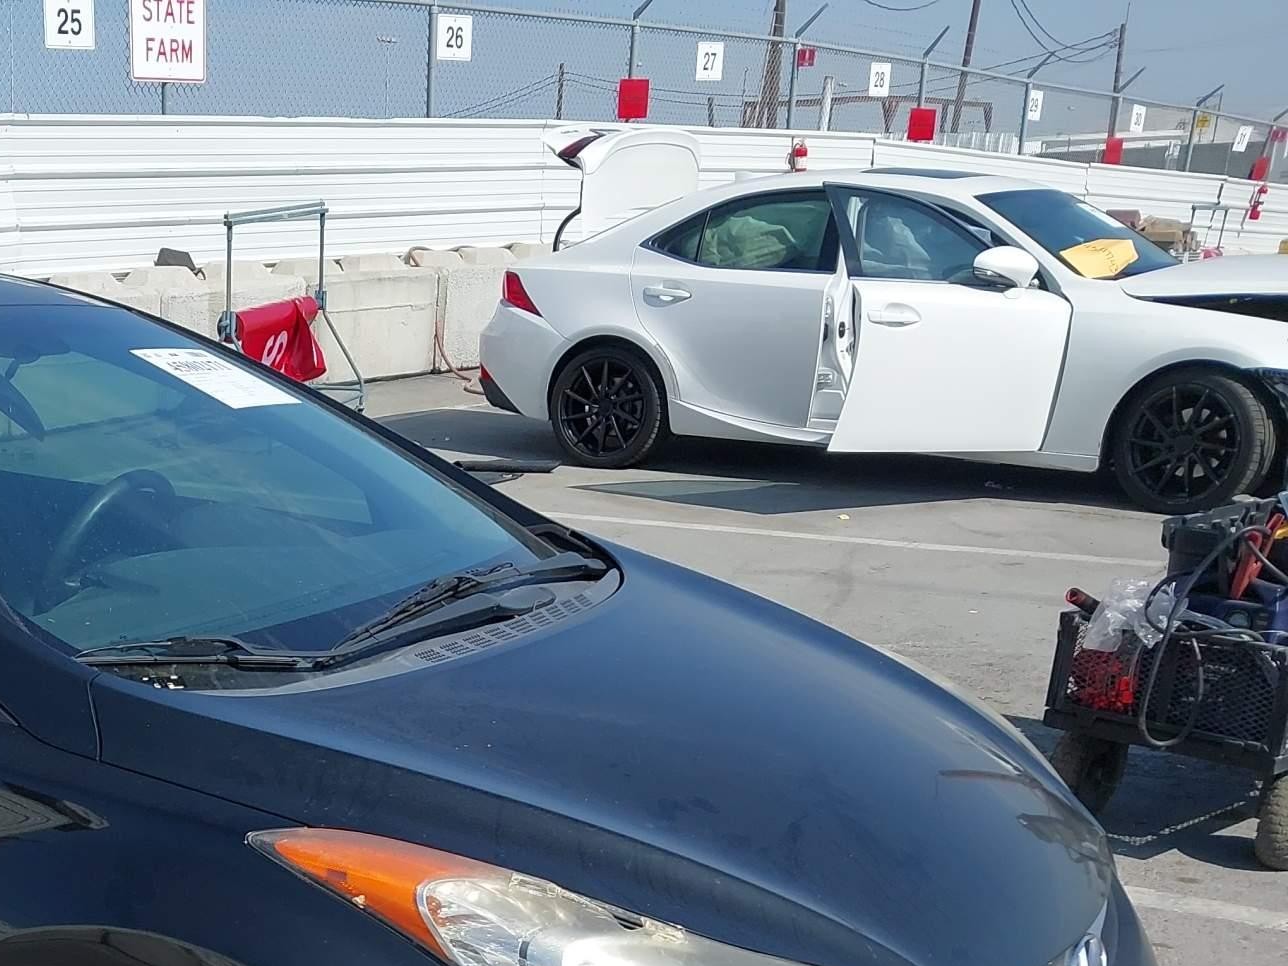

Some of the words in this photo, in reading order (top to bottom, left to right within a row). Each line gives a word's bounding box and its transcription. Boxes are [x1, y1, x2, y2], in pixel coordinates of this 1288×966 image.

[57, 8, 82, 36] 25
[142, 0, 196, 24] STATE
[446, 26, 463, 49] 26
[145, 37, 193, 63] FARM
[703, 52, 717, 71] 27
[874, 71, 885, 88] 28
[1029, 98, 1039, 113] 29
